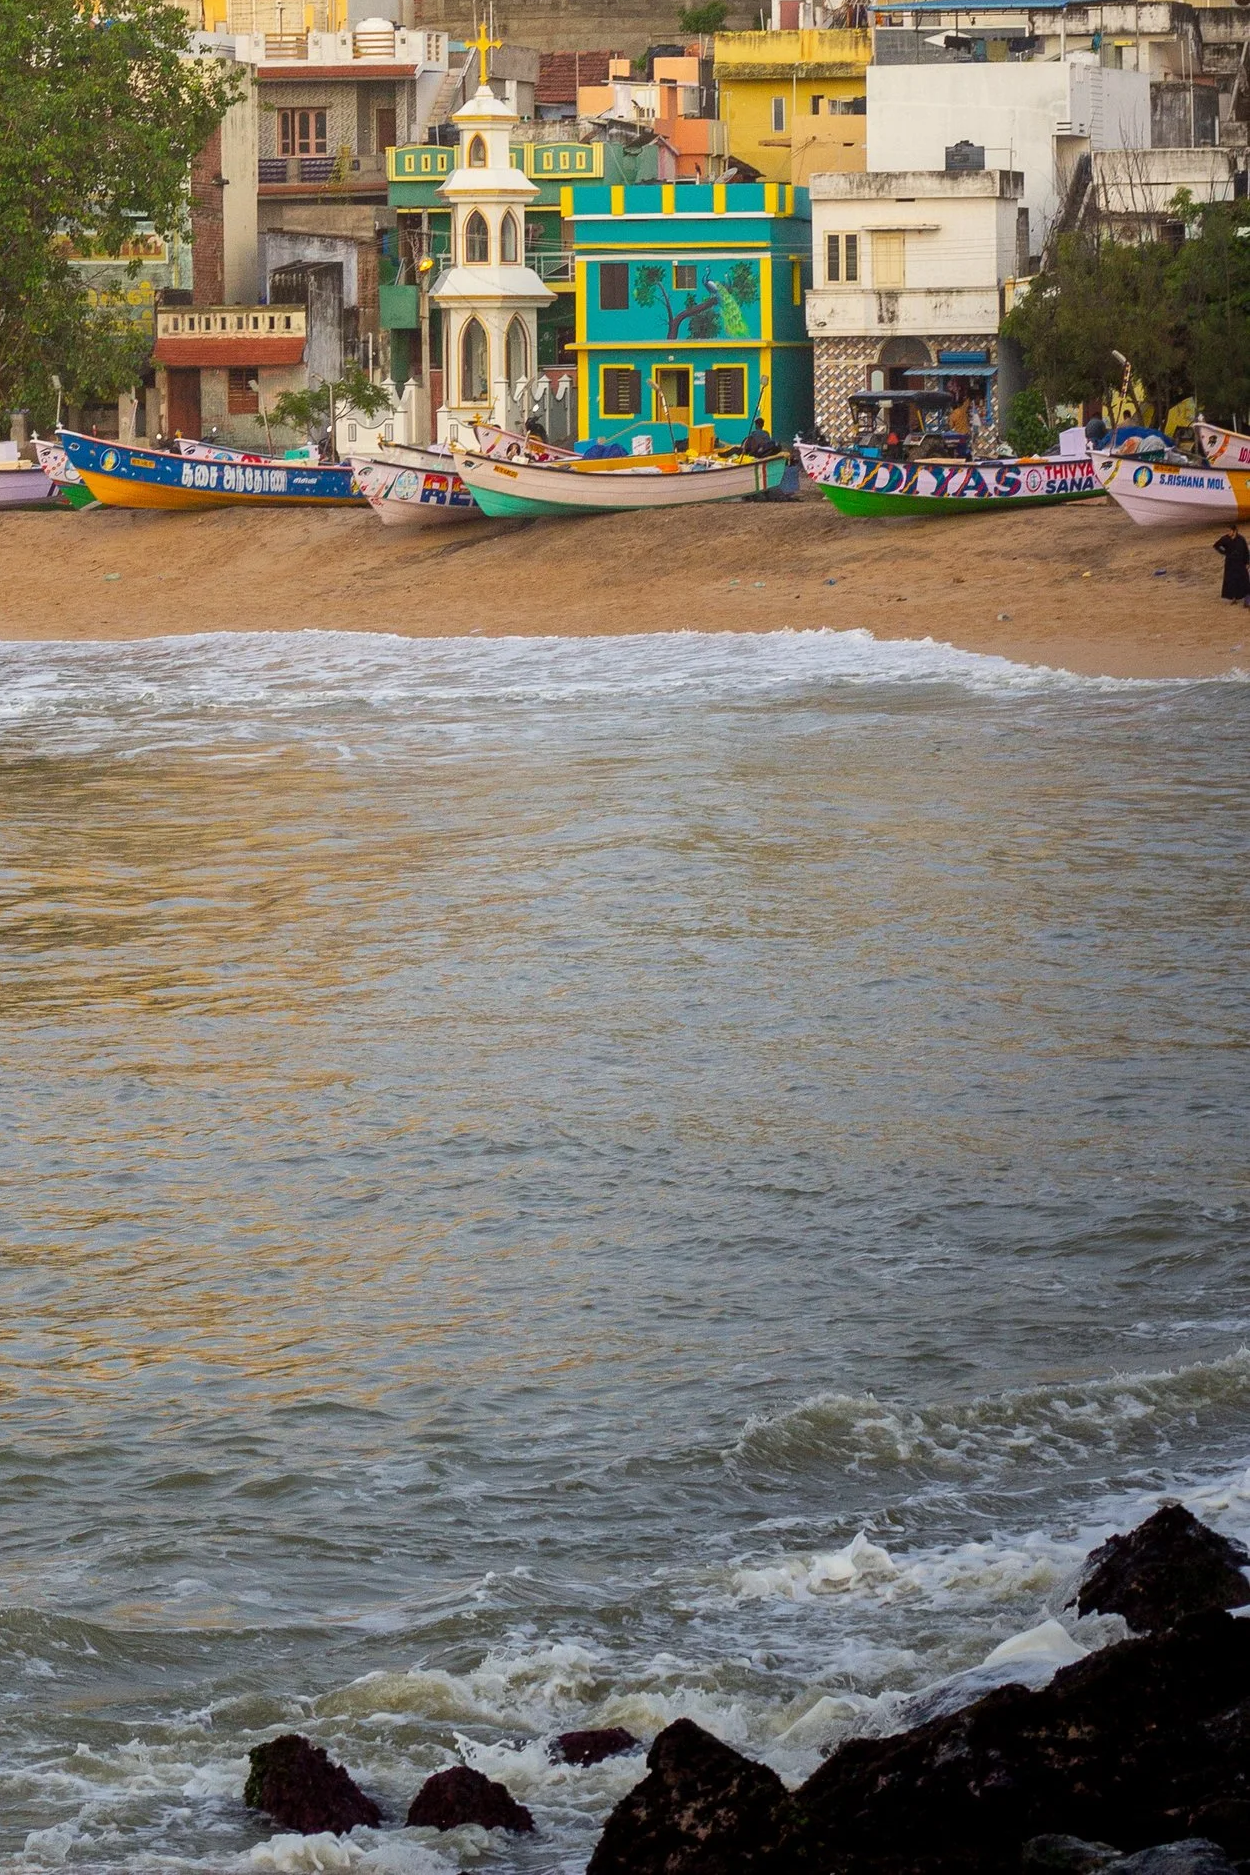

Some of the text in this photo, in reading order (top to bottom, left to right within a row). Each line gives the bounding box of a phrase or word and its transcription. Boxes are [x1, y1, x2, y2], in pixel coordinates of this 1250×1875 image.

[856, 460, 1022, 498] DIYAS
[1044, 462, 1095, 480] THIVYA
[1045, 476, 1095, 494] SANA
[1159, 473, 1225, 491] S.RISHANA MOL
